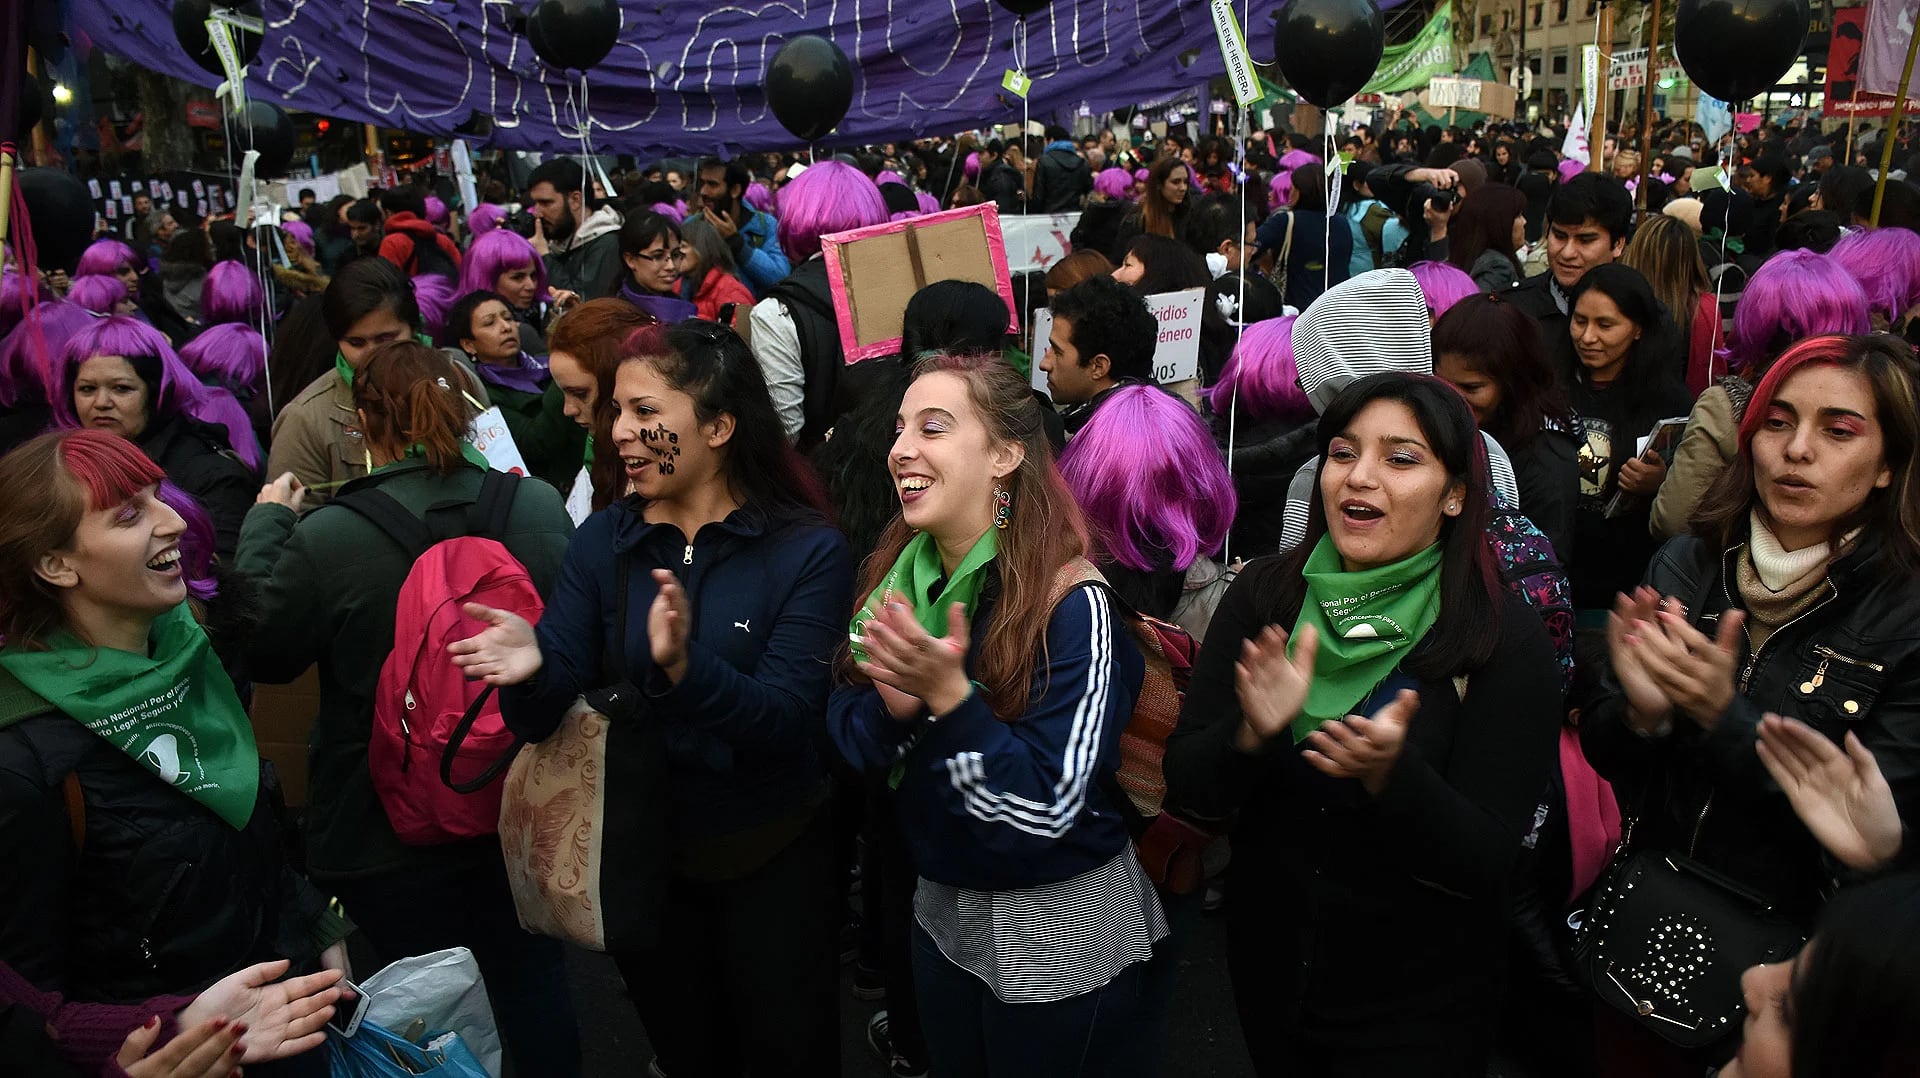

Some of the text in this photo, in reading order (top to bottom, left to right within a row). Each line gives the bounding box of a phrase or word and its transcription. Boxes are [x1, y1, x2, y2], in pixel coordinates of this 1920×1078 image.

[1214, 2, 1249, 96] MARLENE HERRERA
[658, 461, 675, 475] NO
[110, 701, 148, 723] Nacional
[150, 694, 165, 706] Por
[167, 689, 175, 699] el
[141, 703, 172, 720] Seguro
